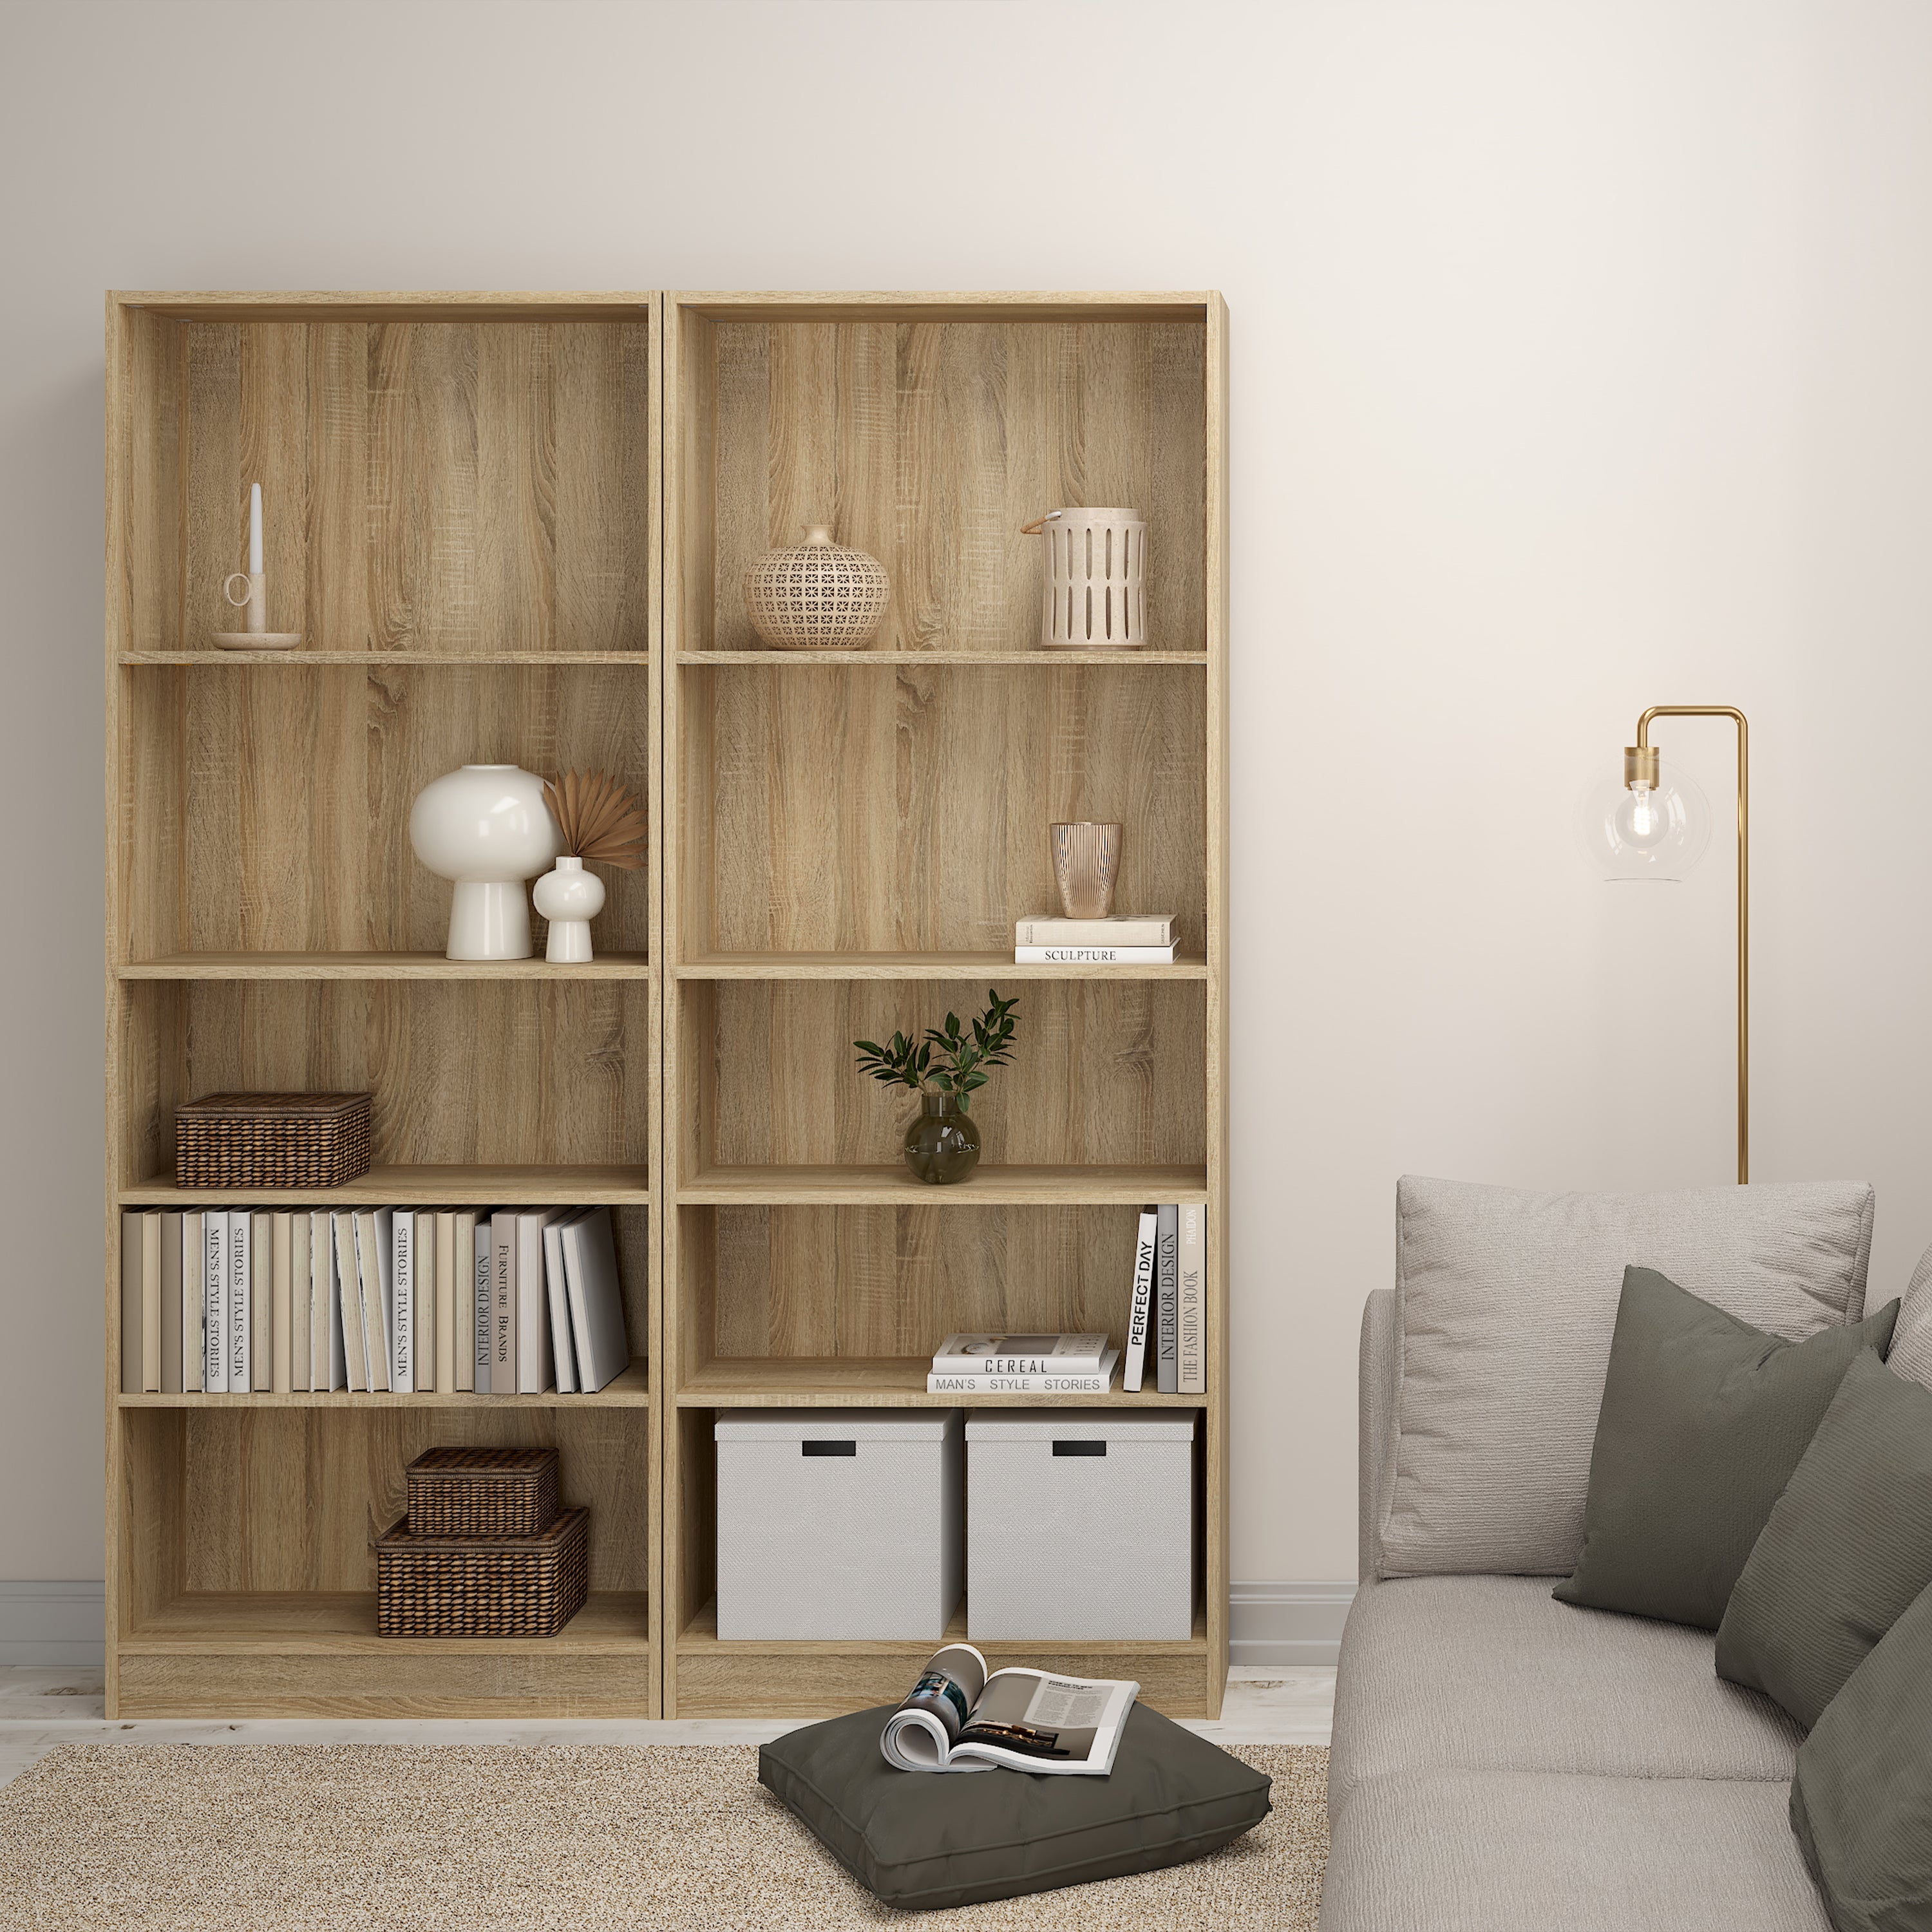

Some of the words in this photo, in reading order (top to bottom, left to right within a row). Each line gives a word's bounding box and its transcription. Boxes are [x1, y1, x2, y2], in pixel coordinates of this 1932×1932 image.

[1045, 951, 1116, 960] SCULPTURE
[1186, 1209, 1196, 1244] PHAIDON
[210, 1229, 220, 1270] MEN'S
[234, 1227, 244, 1285] STORIES
[398, 1227, 408, 1285] STORIES
[1139, 1241, 1153, 1271] DAY
[1161, 1233, 1175, 1287] DESIGN
[210, 1274, 220, 1316] STYLE
[478, 1255, 489, 1302] DESIGN
[1183, 1271, 1198, 1303] BOOK
[234, 1289, 244, 1331] STYLE
[398, 1289, 408, 1331] STYLE
[1132, 1274, 1149, 1345] PERFECT
[1161, 1291, 1175, 1360] INTERIOR
[210, 1320, 220, 1377] STORIES
[478, 1305, 489, 1366] INTERIOR
[1183, 1307, 1198, 1356] FASHION
[234, 1335, 244, 1376] MEN'S
[398, 1335, 408, 1376] MEN'S
[985, 1359, 1048, 1373] CEREAL
[1183, 1359, 1197, 1382] THE
[935, 1379, 976, 1390] MAN'S
[989, 1379, 1030, 1390] STYLE
[1044, 1379, 1100, 1390] STORIES
